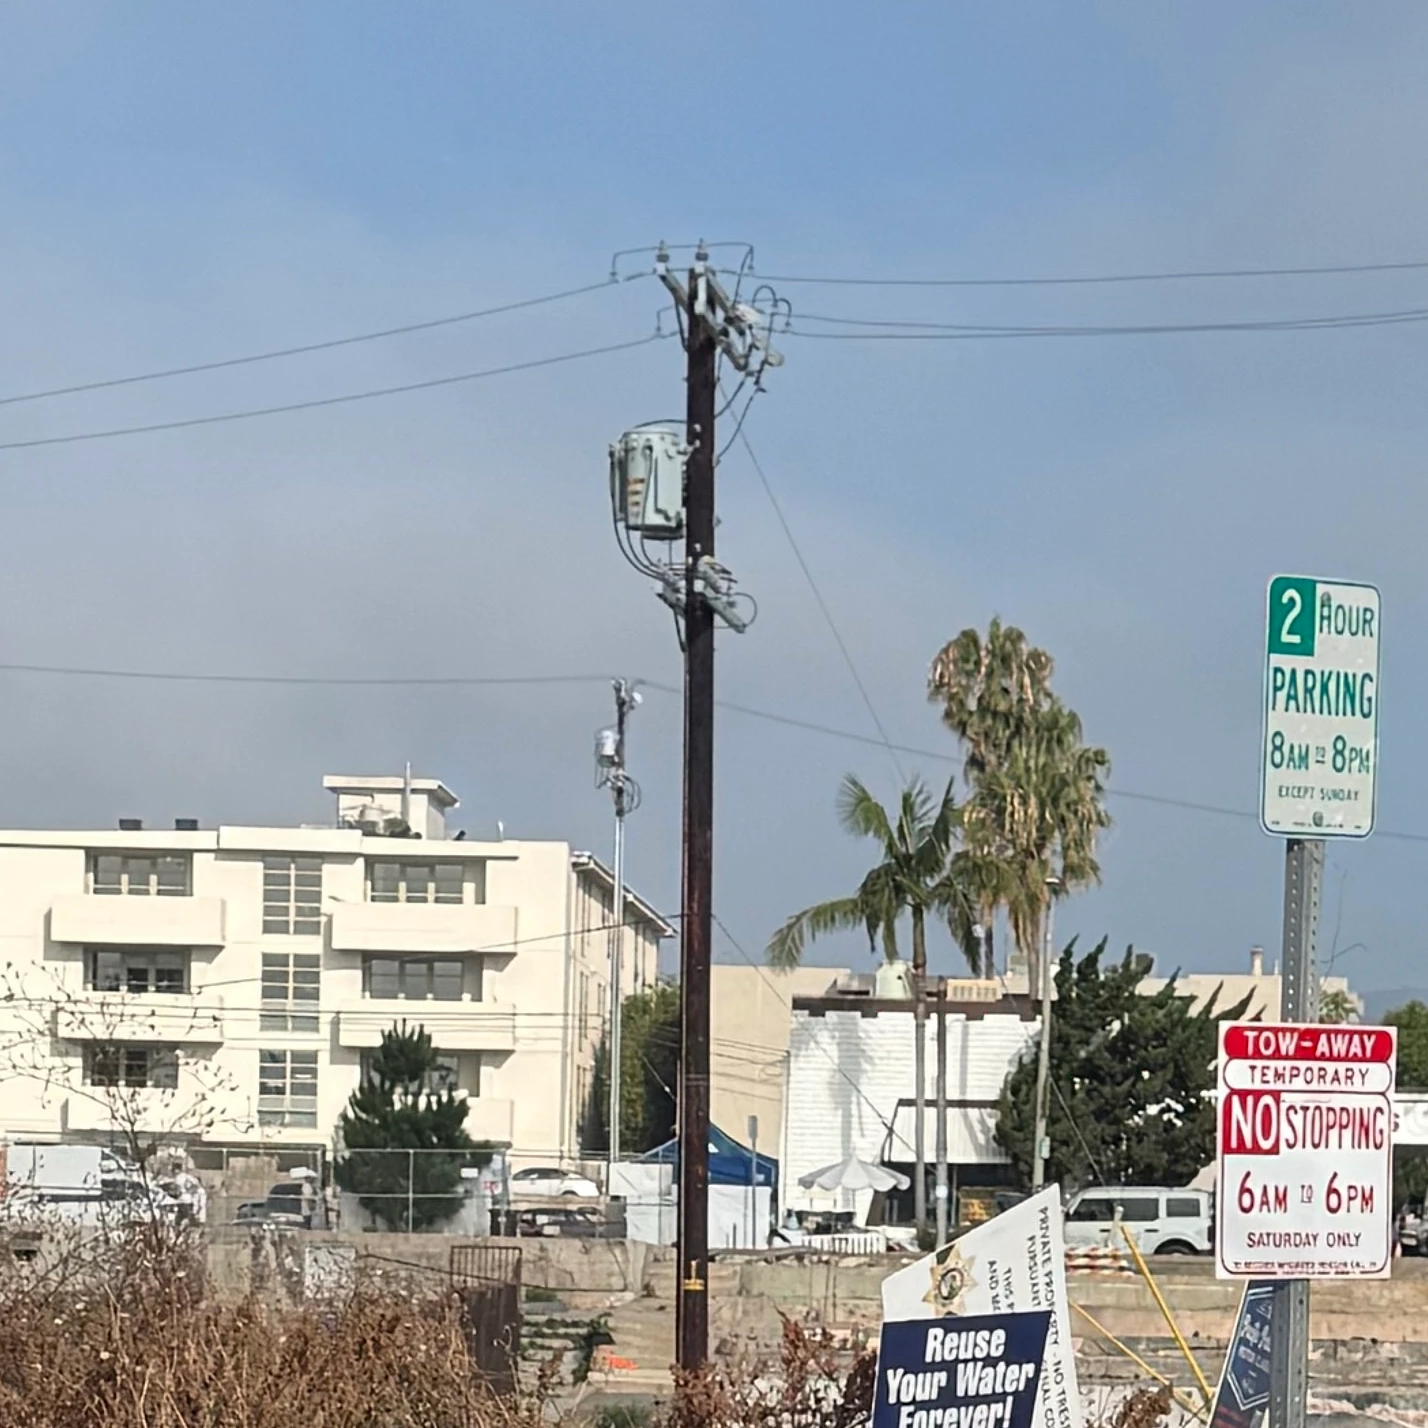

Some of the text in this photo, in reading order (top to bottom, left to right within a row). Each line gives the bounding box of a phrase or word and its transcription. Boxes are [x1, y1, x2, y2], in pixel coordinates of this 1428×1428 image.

[1280, 588, 1375, 644] 2 HOUR
[1271, 666, 1374, 719] PARKING
[1271, 730, 1309, 770] 8AM
[1332, 735, 1370, 774] 8PM
[1278, 784, 1360, 801] EXCEPT SUNDAY
[1243, 1030, 1376, 1058] TOW-AWAY
[1249, 1065, 1369, 1086] TEMPORARY
[1229, 1094, 1384, 1150] NO STOPPING
[1237, 1170, 1374, 1214] 6AM TO 6PM
[1246, 1231, 1362, 1248] SATURDAY ONLY
[987, 1260, 1000, 1290] AND
[1026, 1235, 1041, 1307] PURSUANT
[1037, 1206, 1053, 1267] PRIVATE
[1052, 1360, 1064, 1386] NO
[925, 1327, 1006, 1363] Reuse
[887, 1360, 1035, 1404] Your Water
